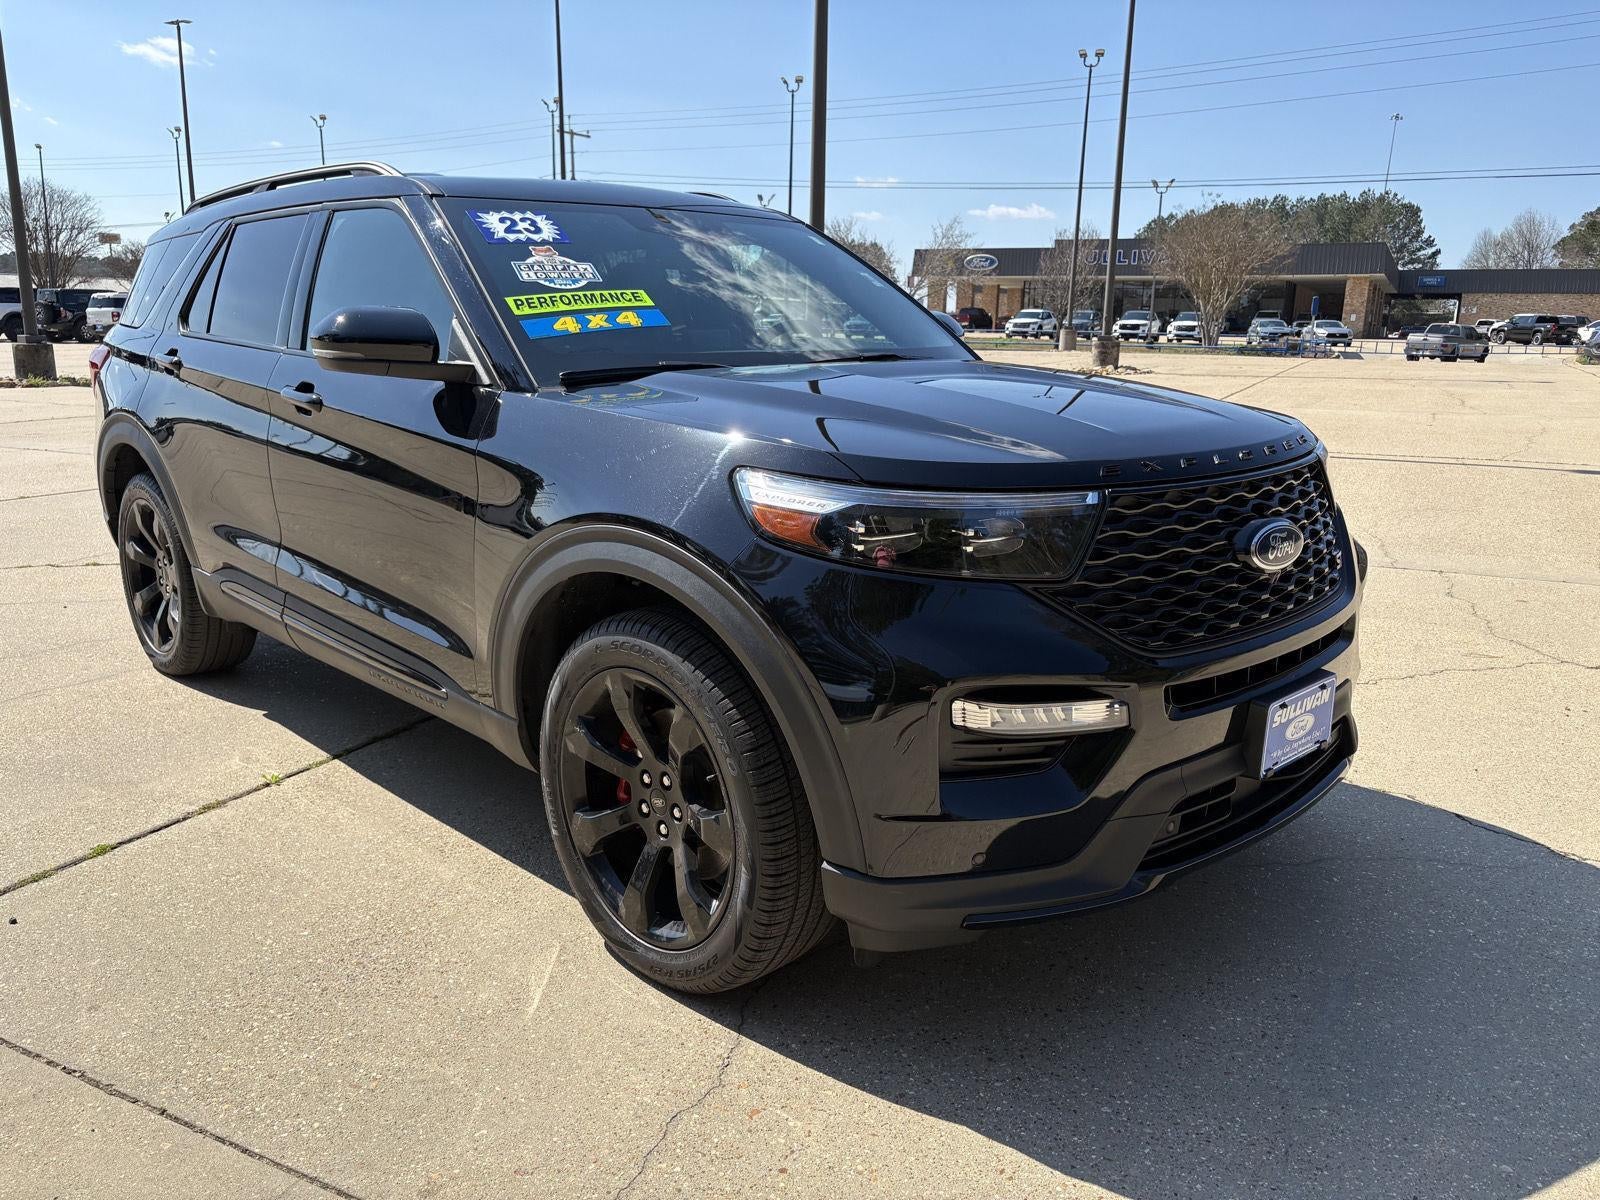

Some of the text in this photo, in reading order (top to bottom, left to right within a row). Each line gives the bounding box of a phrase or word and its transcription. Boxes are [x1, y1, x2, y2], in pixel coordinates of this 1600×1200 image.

[498, 216, 543, 235] 23
[519, 264, 592, 272] CARFAX
[537, 271, 595, 279] OWNER
[512, 291, 645, 311] PERFORMANCE
[1099, 434, 1309, 480] EXPLORER
[754, 491, 827, 509] EXPLORER
[1268, 531, 1296, 560] Ford
[1271, 687, 1332, 729] SULLIVAN
